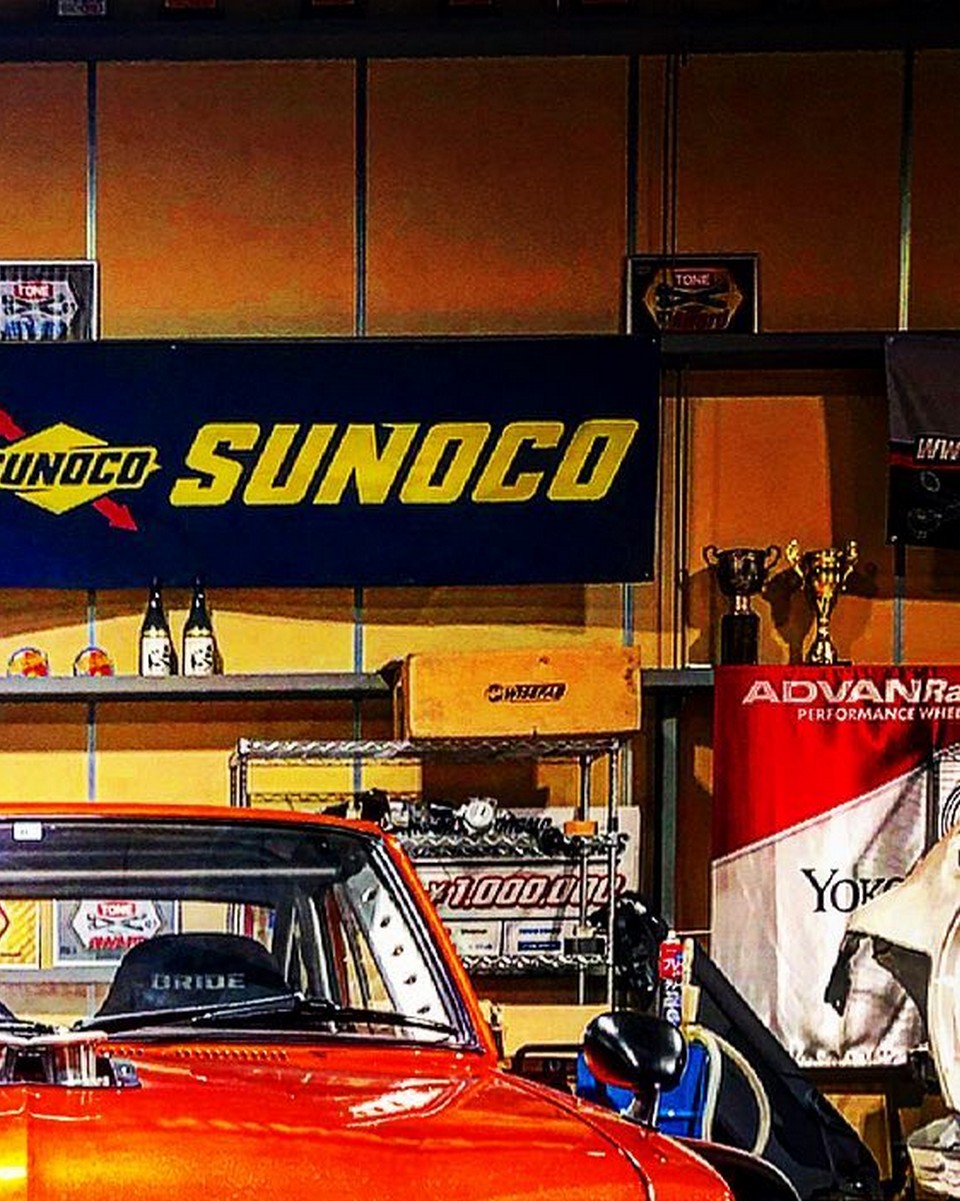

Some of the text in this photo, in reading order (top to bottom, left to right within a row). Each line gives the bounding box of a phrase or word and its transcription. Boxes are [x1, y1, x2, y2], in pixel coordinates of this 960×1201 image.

[675, 273, 711, 287] TONE
[17, 282, 50, 298] TONE
[170, 419, 640, 507] SUNOCO
[741, 679, 922, 704] ADVAN
[797, 707, 915, 721] PERFORMANCE
[150, 972, 246, 990] BRIDE
